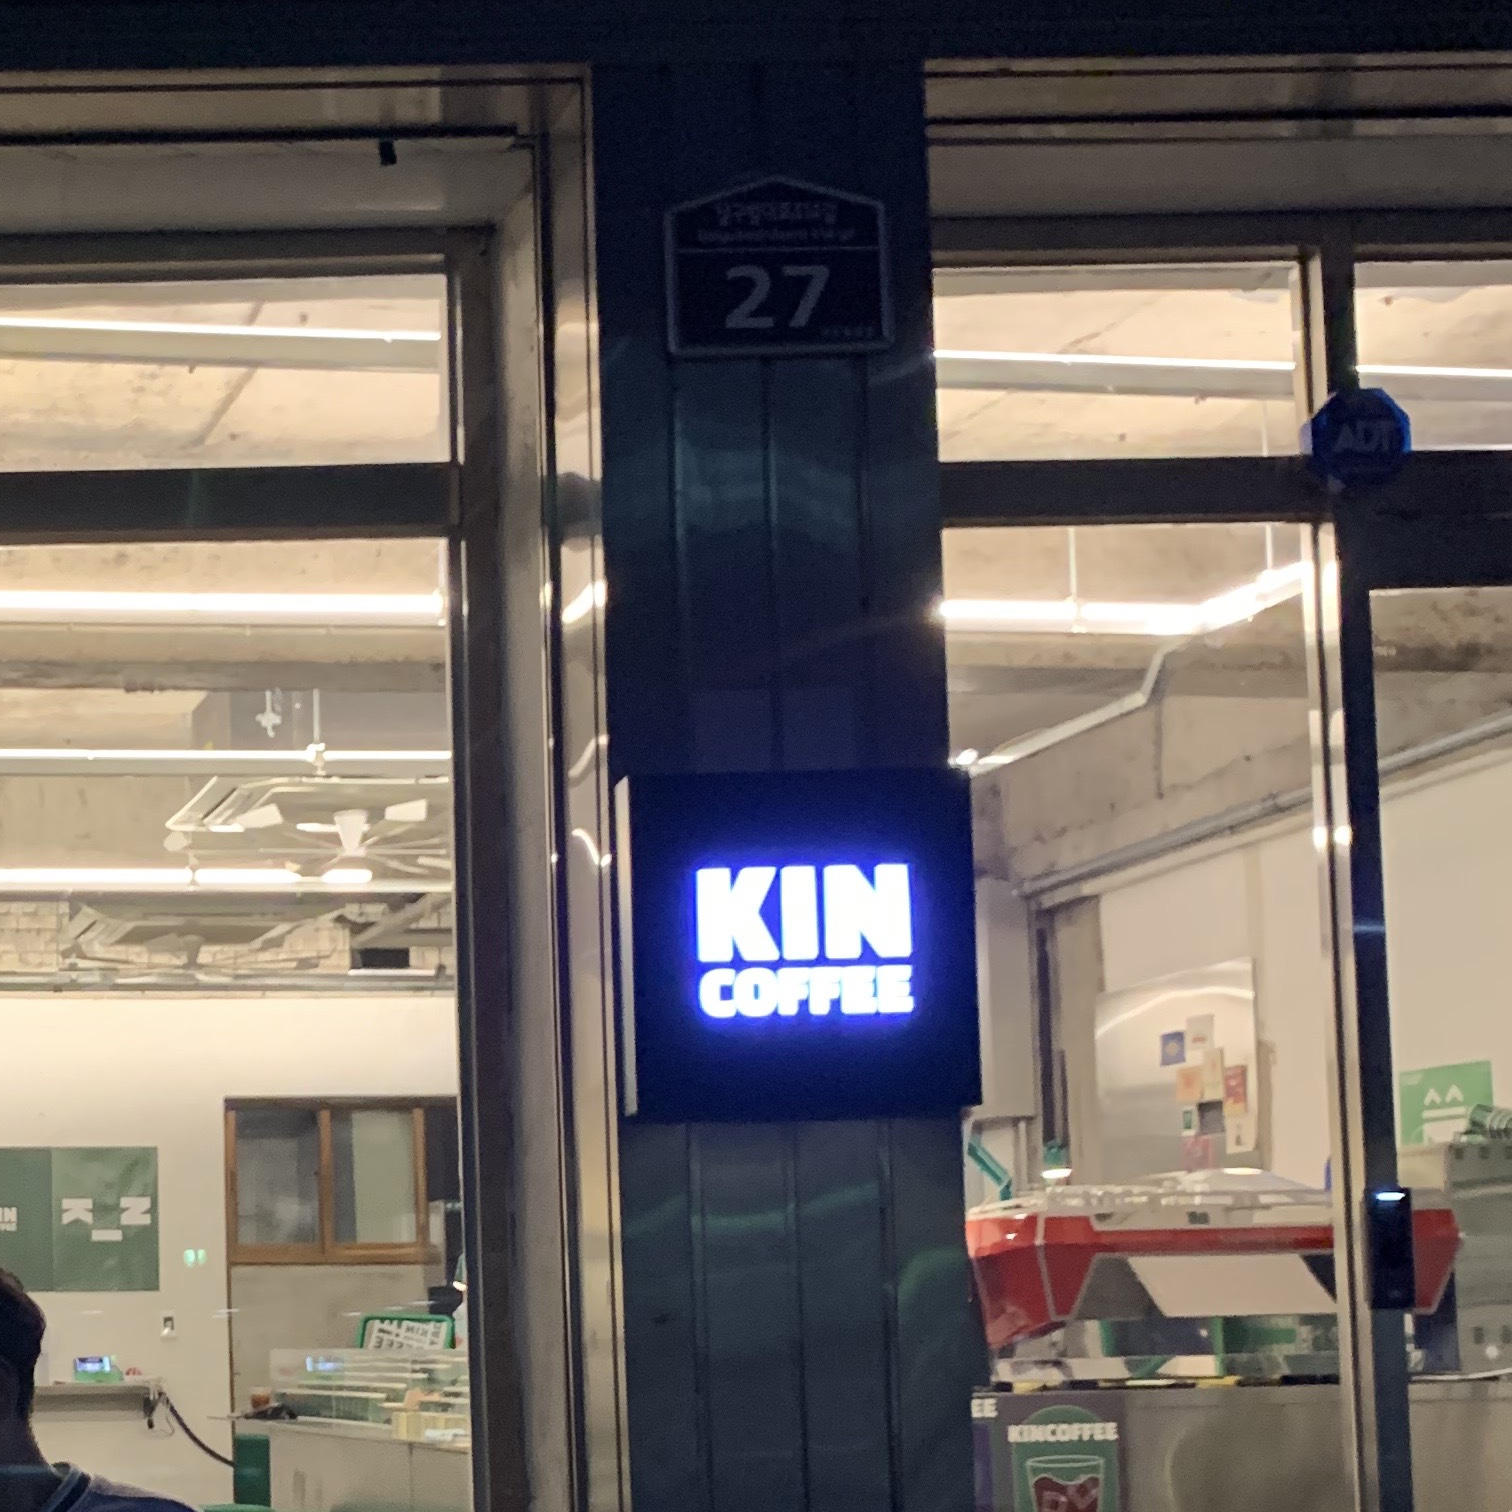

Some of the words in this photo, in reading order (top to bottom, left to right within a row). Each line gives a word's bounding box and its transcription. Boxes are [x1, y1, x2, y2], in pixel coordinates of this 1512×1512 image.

[725, 264, 830, 329] 27
[1333, 420, 1395, 452] ADT
[696, 863, 913, 962] KIN
[699, 965, 915, 1018] COFFEE
[1007, 1422, 1119, 1442] KINCOFFEE
